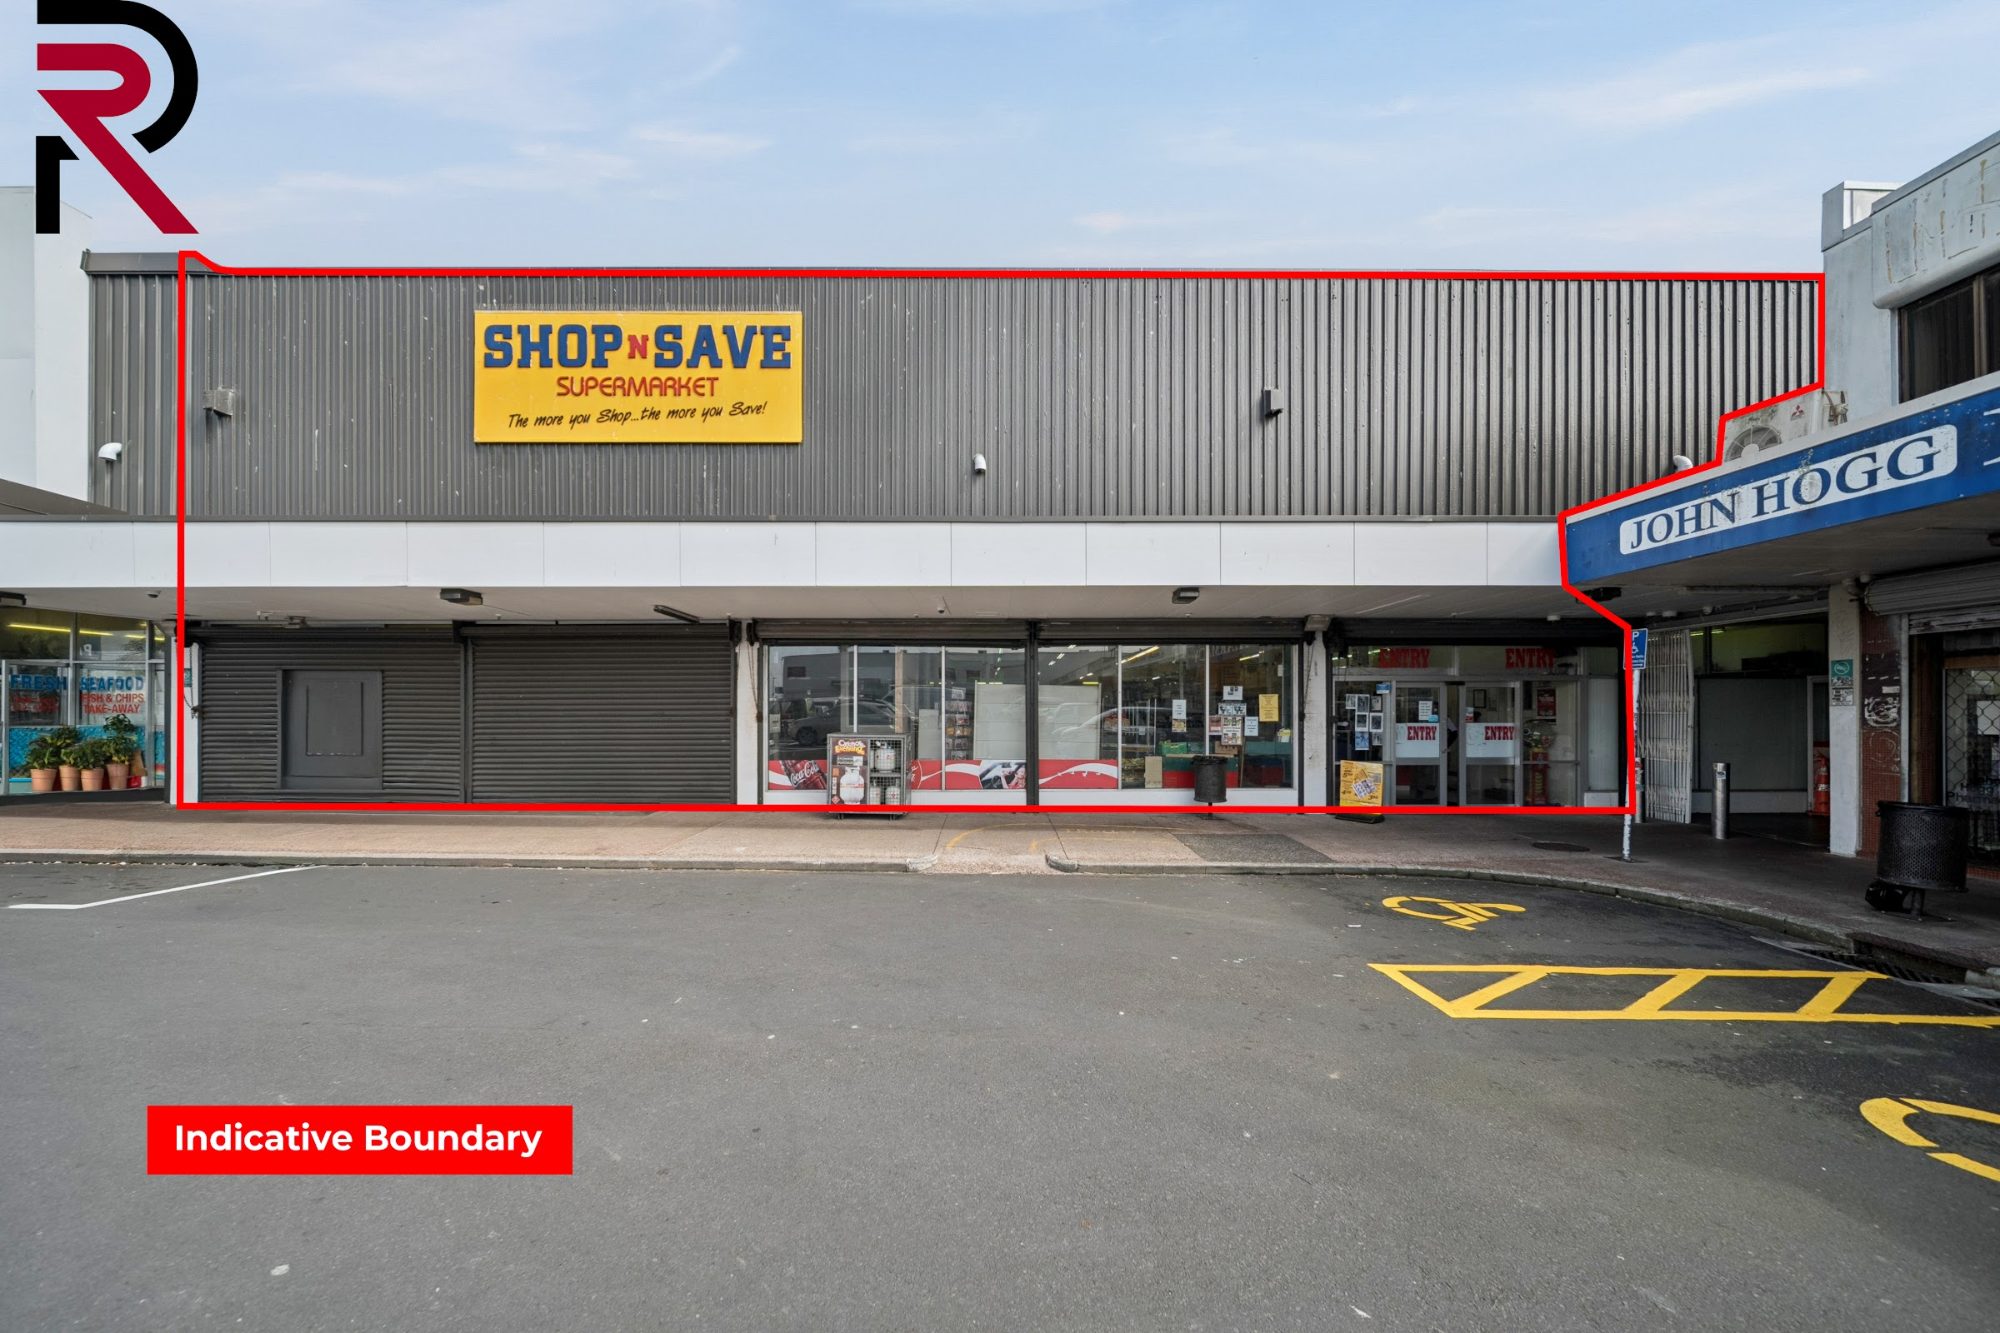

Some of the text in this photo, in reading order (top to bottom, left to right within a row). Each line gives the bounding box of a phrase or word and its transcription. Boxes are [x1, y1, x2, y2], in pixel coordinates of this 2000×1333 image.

[484, 324, 791, 369] SHOP N SAVE
[556, 376, 719, 397] SUPERMARKET
[509, 414, 528, 428] The
[534, 415, 563, 426] more
[569, 414, 591, 430] you
[666, 407, 696, 419] more
[702, 406, 723, 423] you
[729, 401, 767, 416] Save!
[1631, 491, 1739, 549] JOHN
[1752, 435, 1942, 517] HOGG
[1632, 631, 1640, 641] P
[1378, 648, 1431, 668] ENTRY
[1505, 648, 1556, 668] ENTRY
[11, 675, 144, 690] FRESH SEAFOOD
[82, 693, 144, 705] FISH & CHIPS
[84, 704, 140, 714] TAKE-AWAY
[1407, 726, 1437, 740] ENTRY
[1485, 726, 1514, 740] ENTRY
